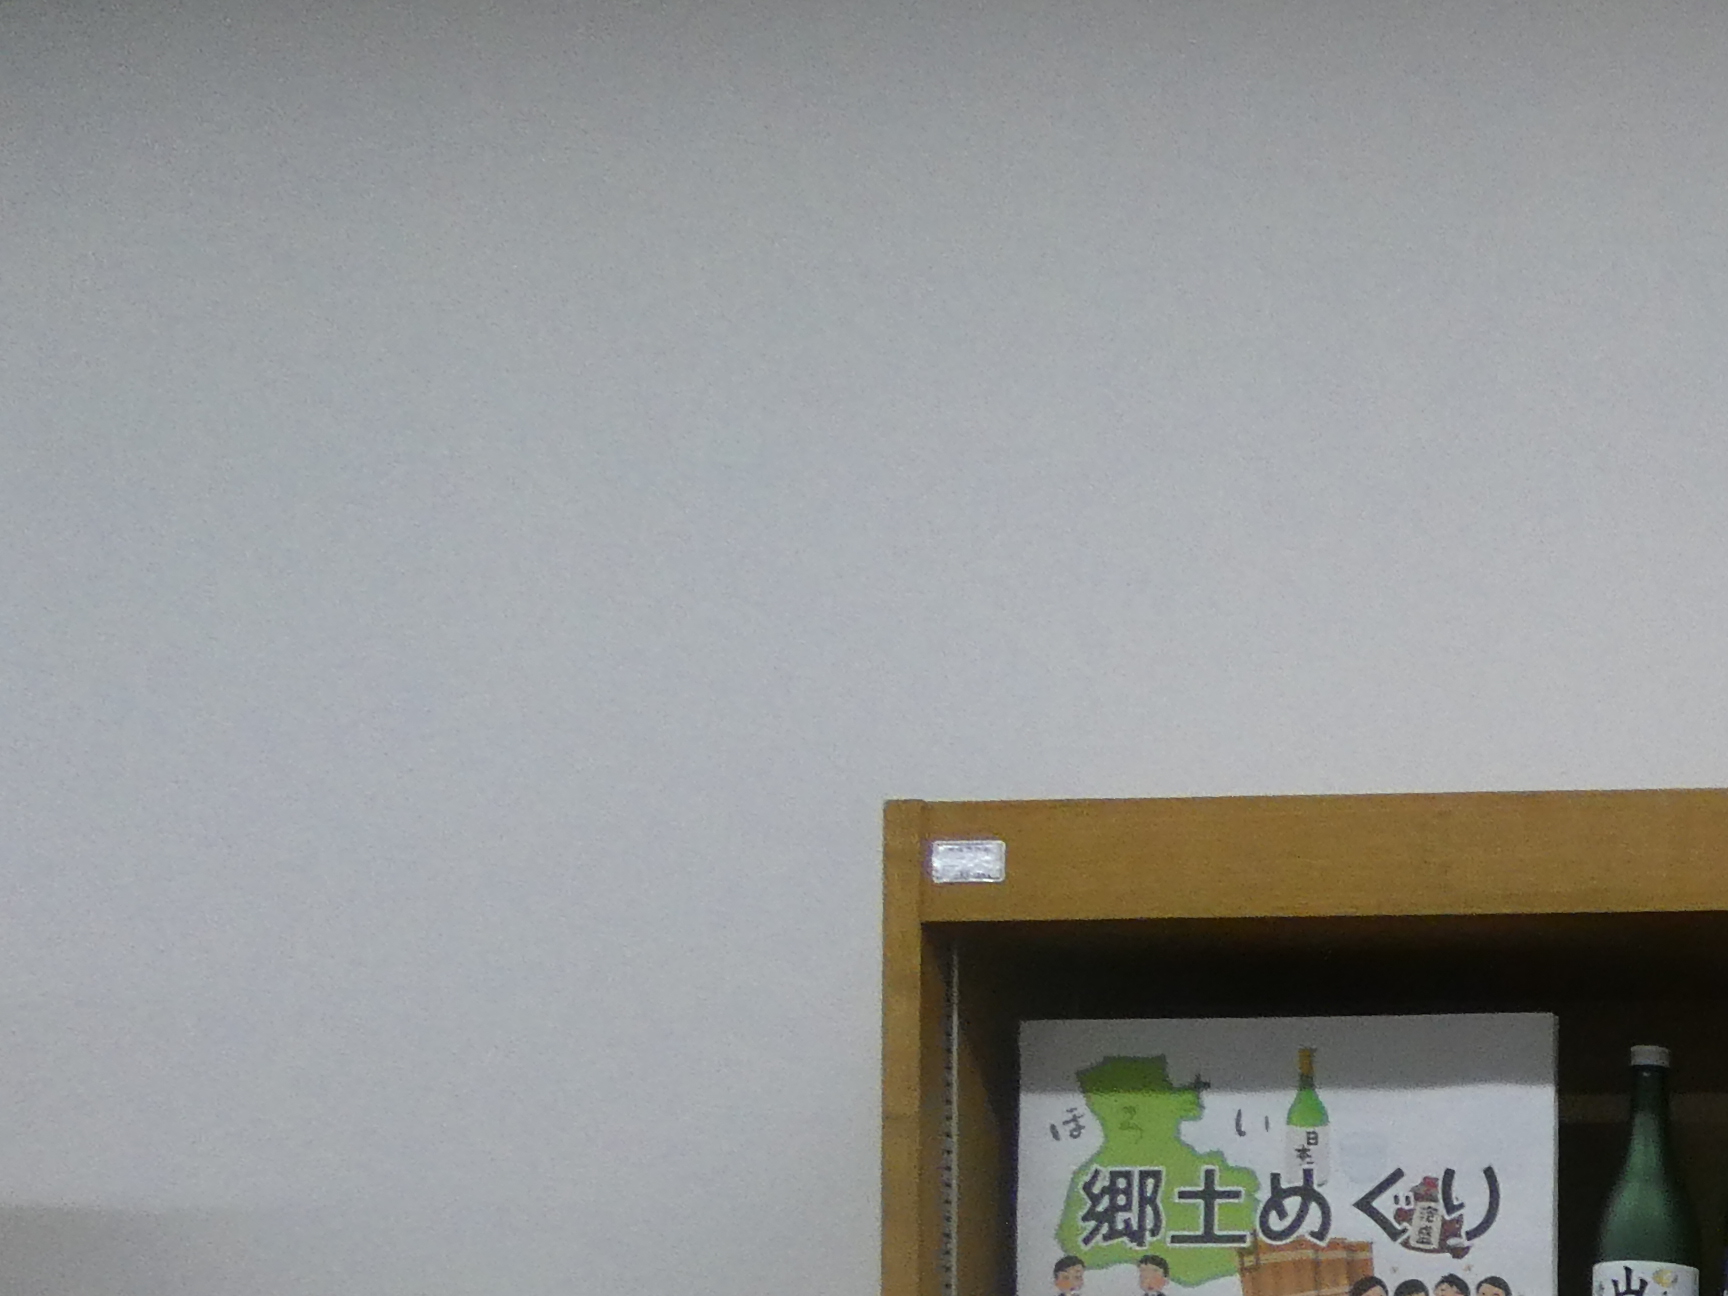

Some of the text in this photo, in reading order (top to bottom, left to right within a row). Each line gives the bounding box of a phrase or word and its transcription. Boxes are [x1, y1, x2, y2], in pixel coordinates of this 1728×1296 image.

[1082, 1167, 1499, 1248] 郷土めぐり
